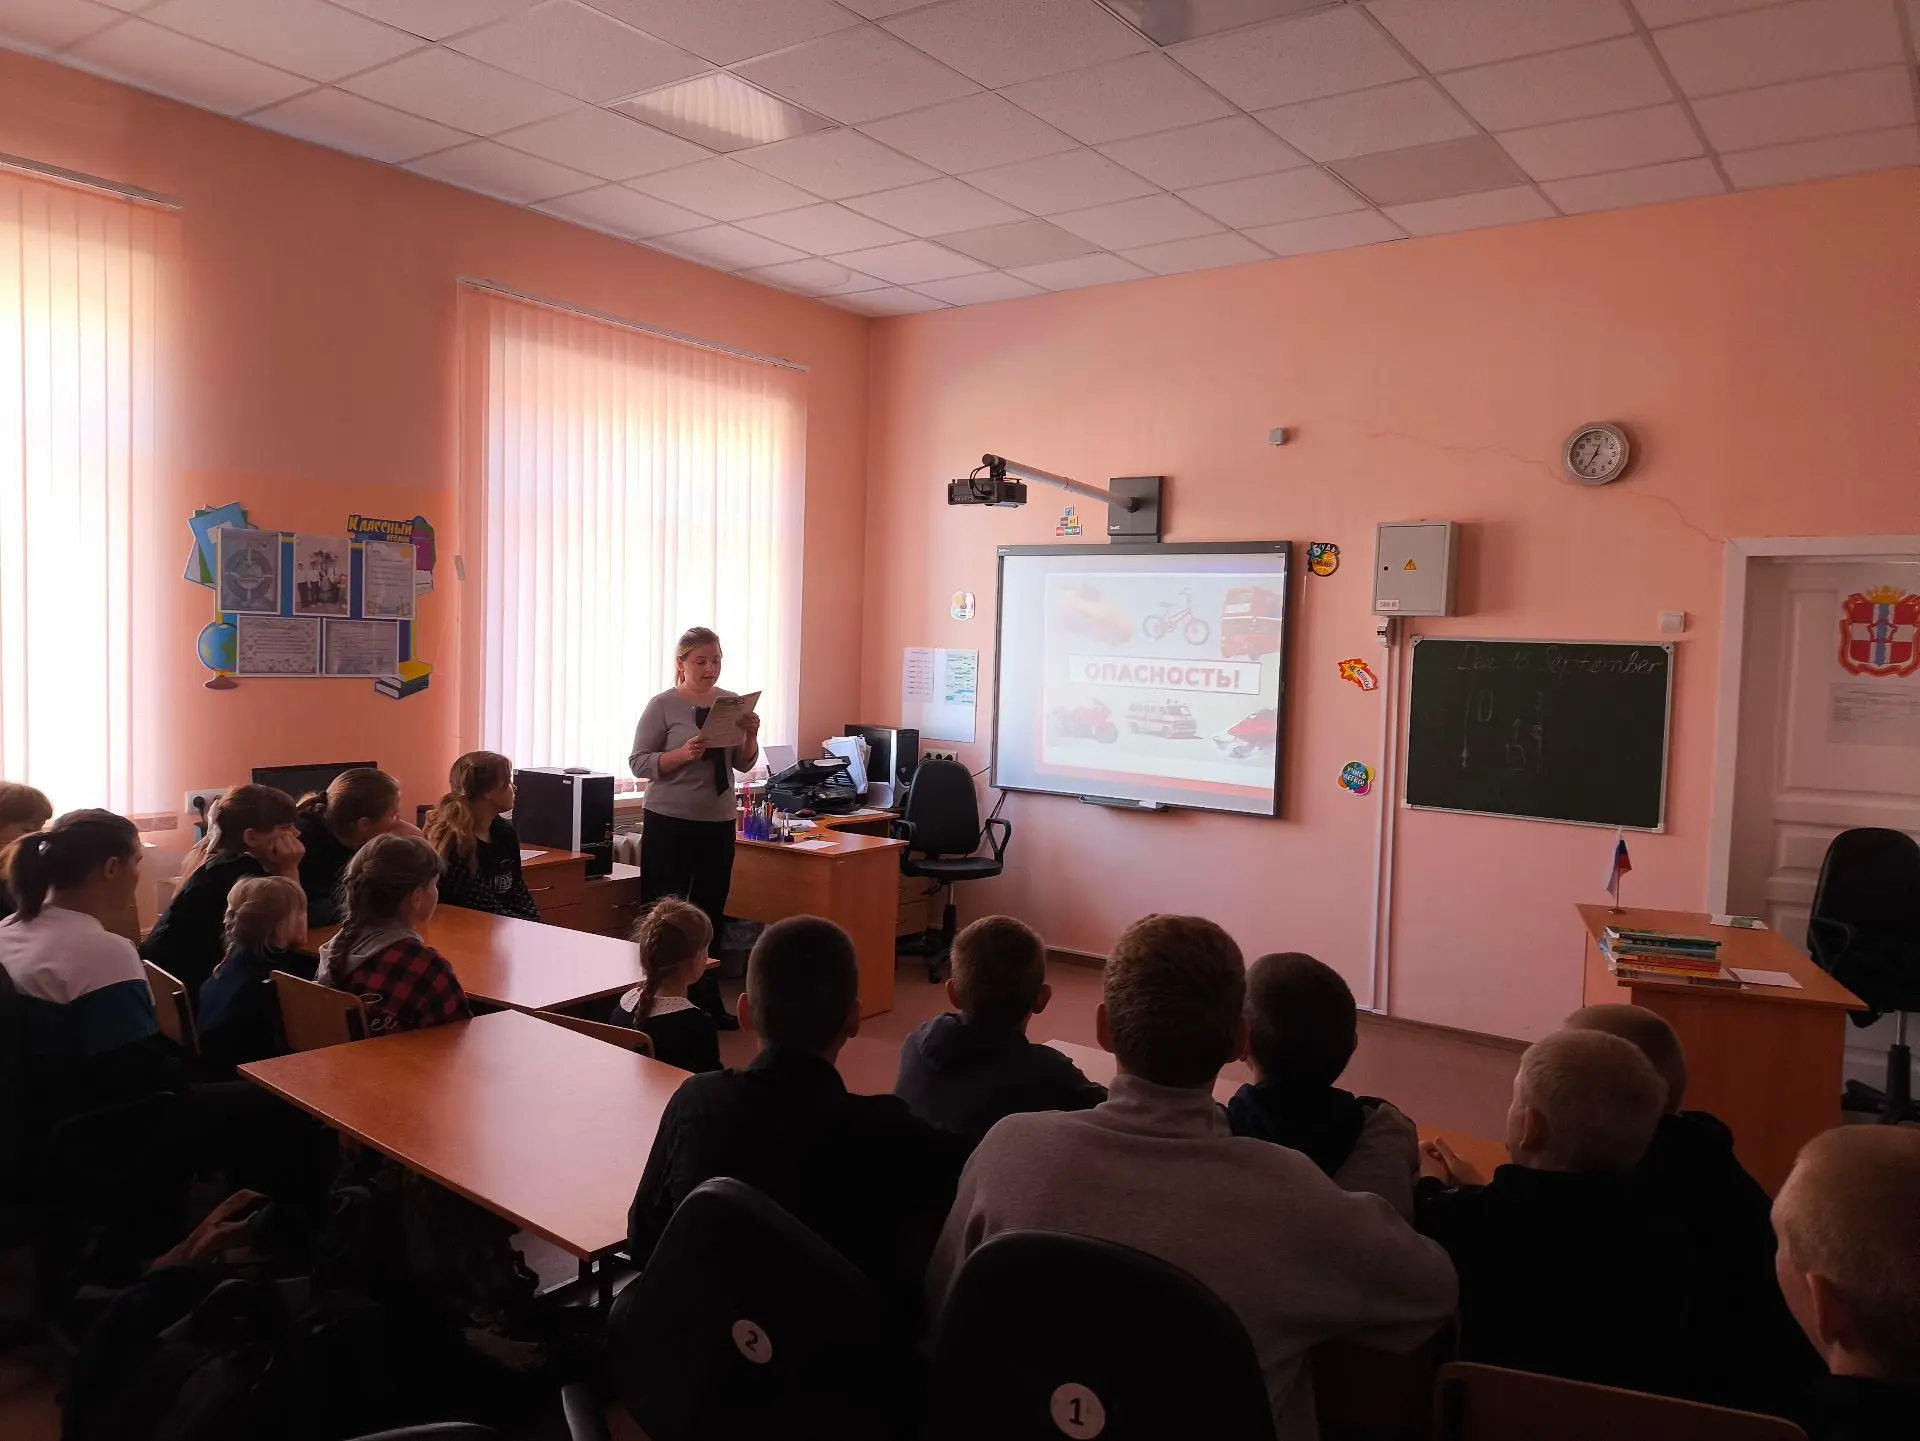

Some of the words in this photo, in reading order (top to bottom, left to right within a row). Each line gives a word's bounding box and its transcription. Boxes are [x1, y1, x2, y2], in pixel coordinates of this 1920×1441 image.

[1084, 662, 1241, 690] ОПАСНОСТЬ!
[745, 1329, 758, 1352] 2
[1068, 1397, 1084, 1426] 1
